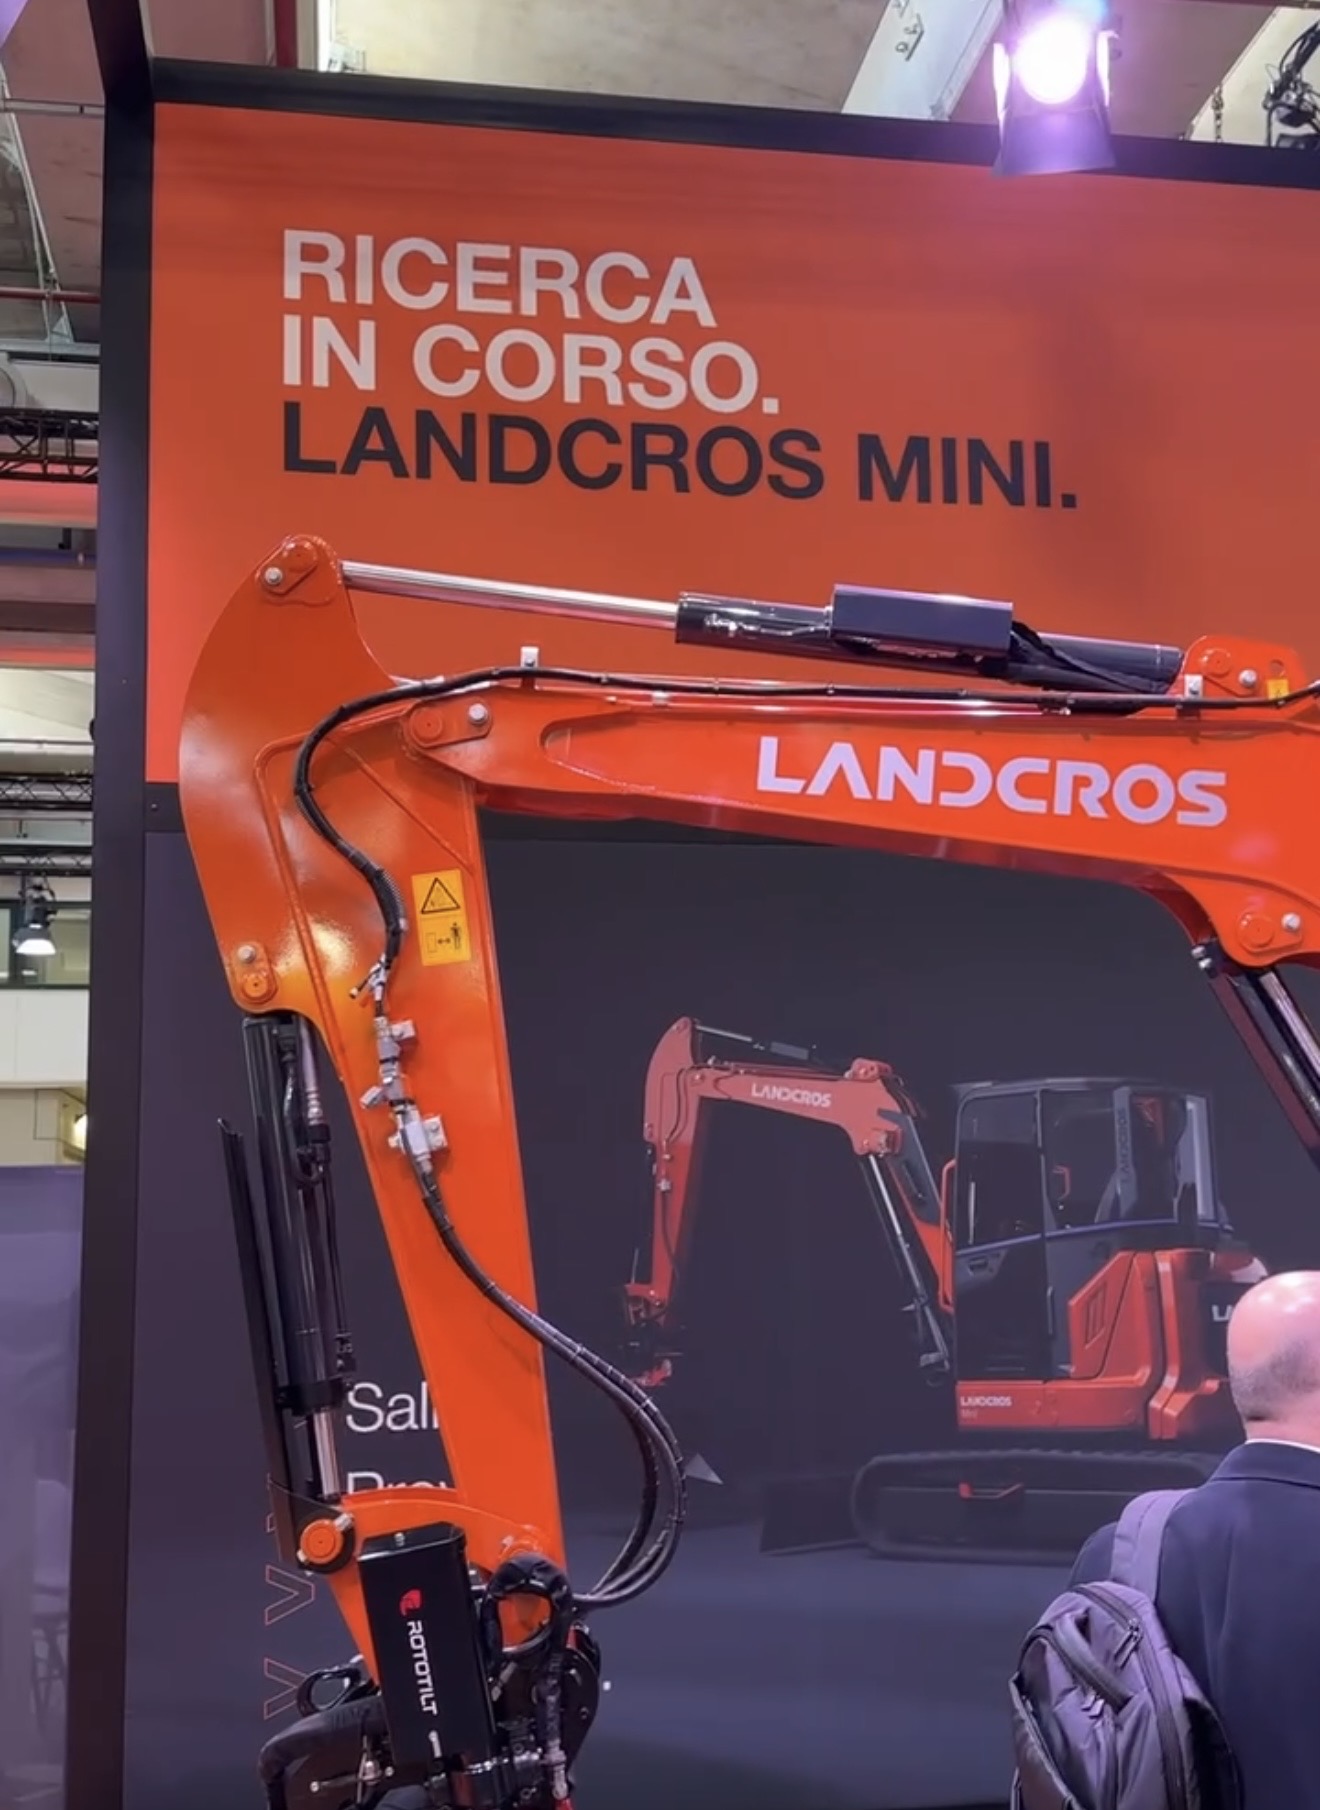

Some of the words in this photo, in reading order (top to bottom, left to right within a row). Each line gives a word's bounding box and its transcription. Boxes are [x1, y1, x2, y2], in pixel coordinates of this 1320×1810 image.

[283, 228, 717, 328] RICERCA
[283, 314, 377, 392] IN
[412, 322, 781, 415] CORSO.
[282, 402, 824, 501] LANDCROS
[856, 433, 1078, 510] MINI.
[756, 735, 1228, 828] LANDCROS
[751, 1083, 832, 1108] LANDCROS
[406, 1619, 438, 1716] ROTOTILT
